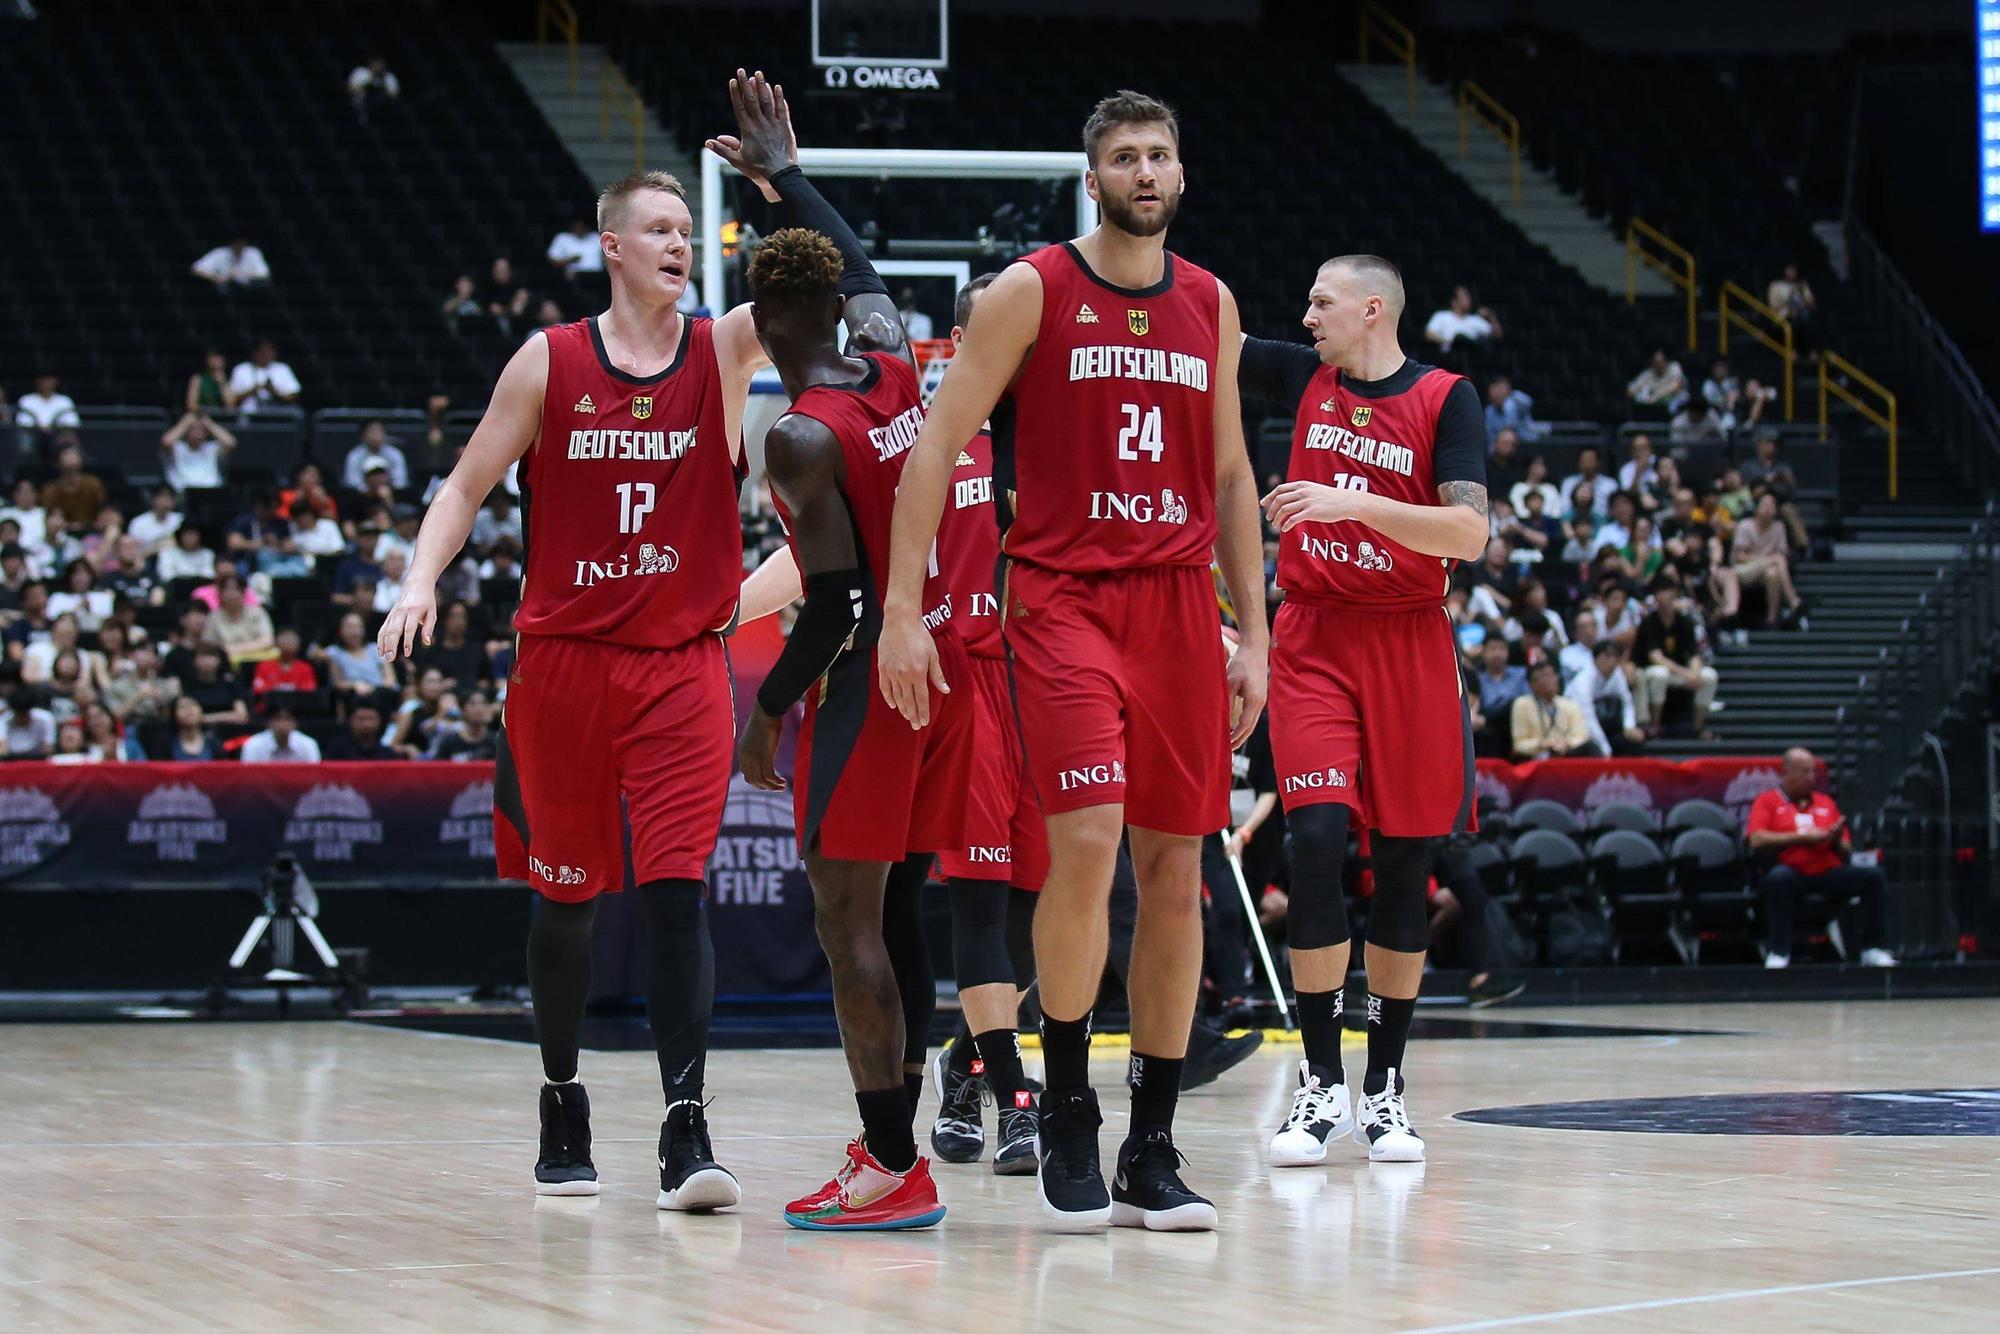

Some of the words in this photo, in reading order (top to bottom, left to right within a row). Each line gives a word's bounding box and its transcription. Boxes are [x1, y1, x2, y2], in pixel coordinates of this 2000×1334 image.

[853, 66, 940, 89] OMEGA
[1076, 314, 1100, 323] PEAK
[1069, 346, 1208, 392] DEUTSCHLAND
[574, 404, 597, 415] PEAK
[1118, 403, 1164, 462] 24
[955, 457, 976, 467] PEAK
[1305, 423, 1414, 477] DEUTSCHLAND
[616, 482, 655, 534] 12
[955, 476, 995, 510] DEU
[1088, 492, 1154, 523] ING
[1301, 532, 1349, 562] ING
[573, 554, 630, 586] ING
[969, 593, 998, 616] IN
[1058, 765, 1110, 791] ING
[1285, 772, 1324, 794] ING
[529, 856, 553, 882] ING
[712, 836, 800, 872] ATSU
[969, 846, 1006, 863] ING
[716, 870, 784, 905] FIVE
